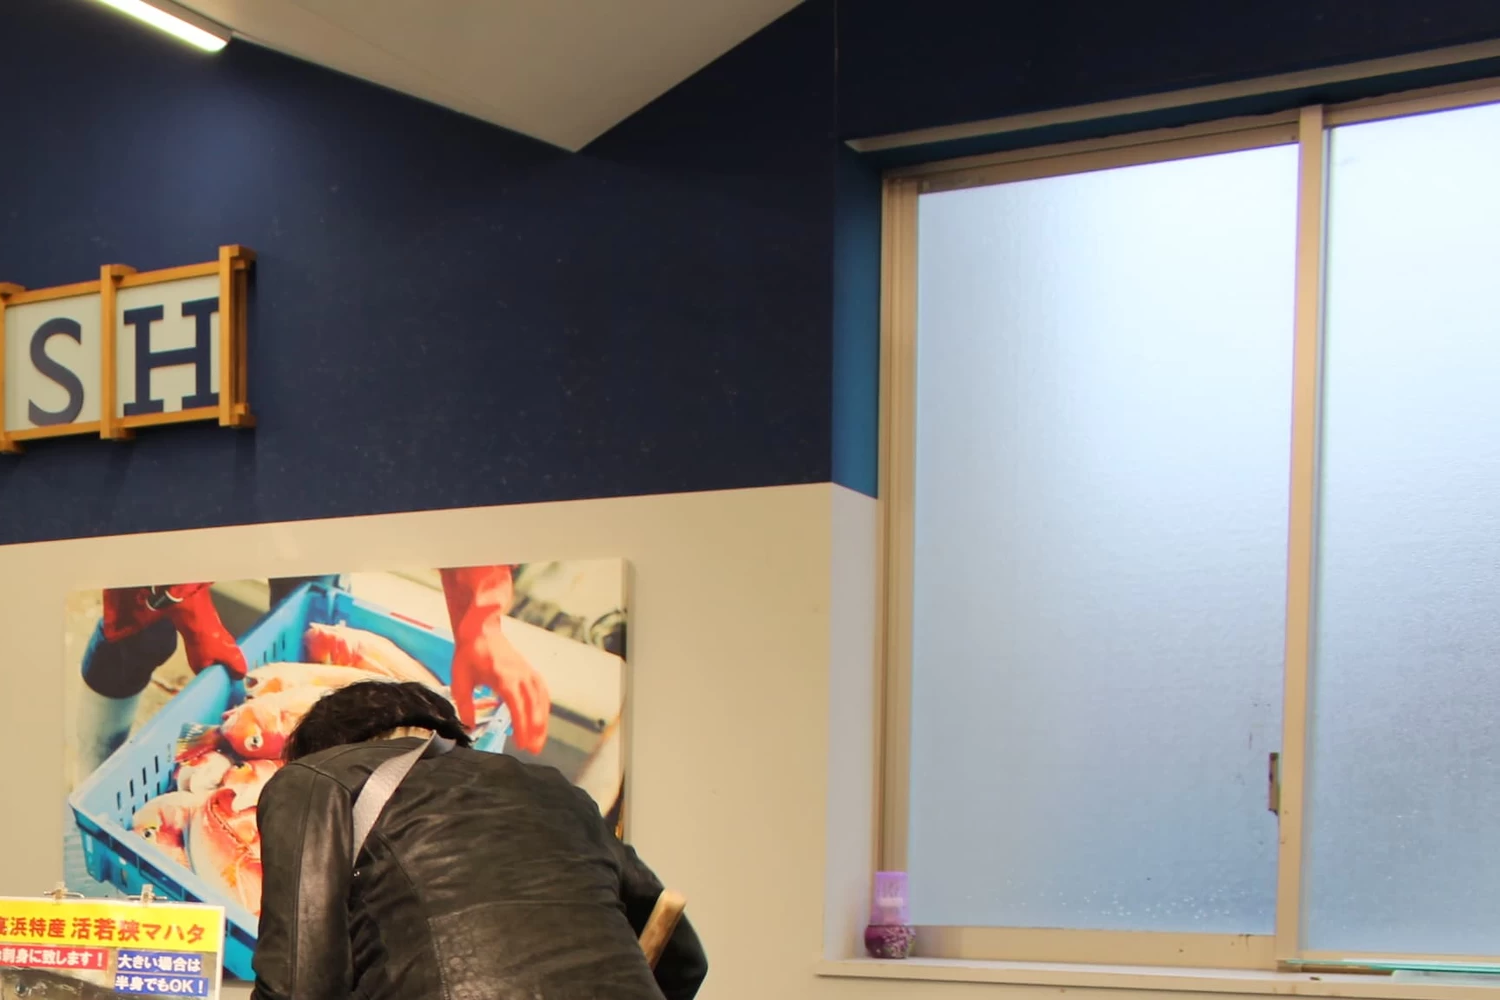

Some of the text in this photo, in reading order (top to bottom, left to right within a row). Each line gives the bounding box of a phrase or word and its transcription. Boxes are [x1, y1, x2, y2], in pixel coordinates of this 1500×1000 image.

[70, 917, 205, 944] 活若狭マハタ
[117, 953, 202, 973] 大きい場合は
